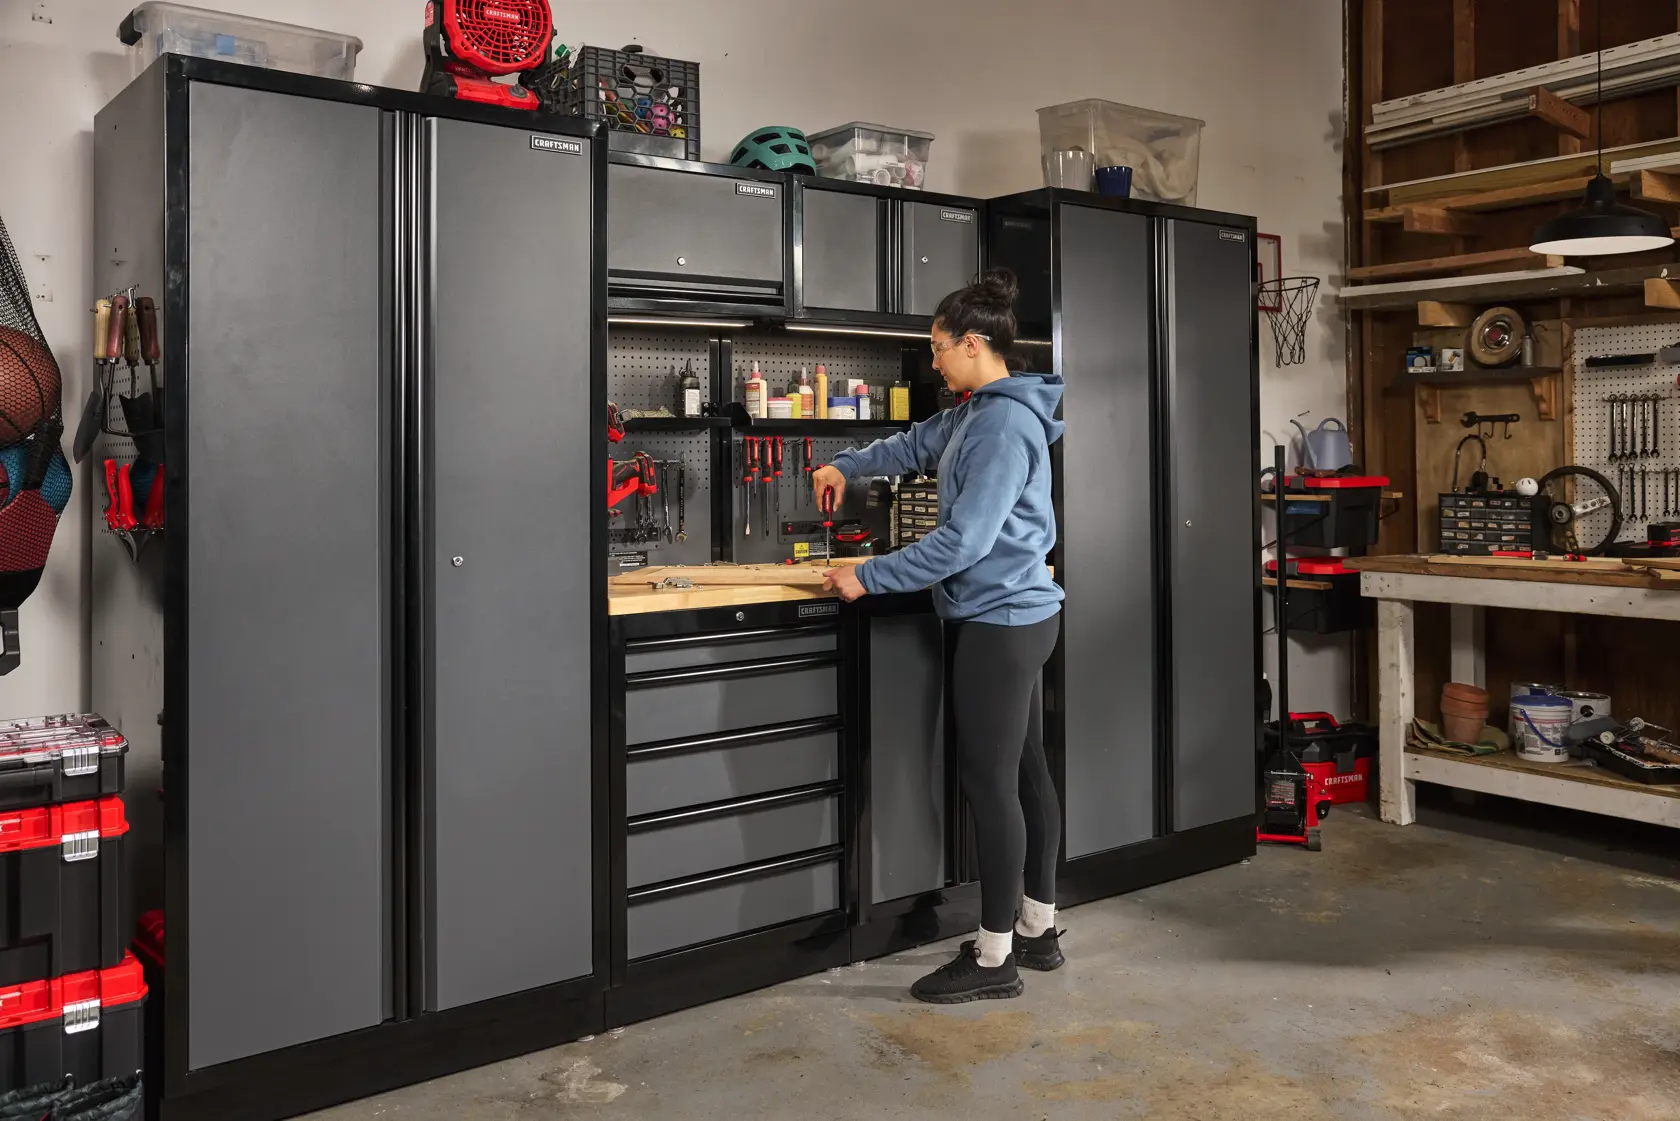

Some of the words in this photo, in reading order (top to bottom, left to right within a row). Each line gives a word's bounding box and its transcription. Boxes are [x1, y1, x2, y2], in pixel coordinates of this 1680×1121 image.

[486, 9, 519, 20] CRAFTSMAN
[534, 139, 580, 151] CRAFTSMAN
[739, 185, 774, 196] CRAFTSMAN
[942, 211, 971, 221] CRAFTSMAN
[800, 605, 837, 615] CRAFTSMAN
[1324, 774, 1363, 786] CRAFTSMAN
